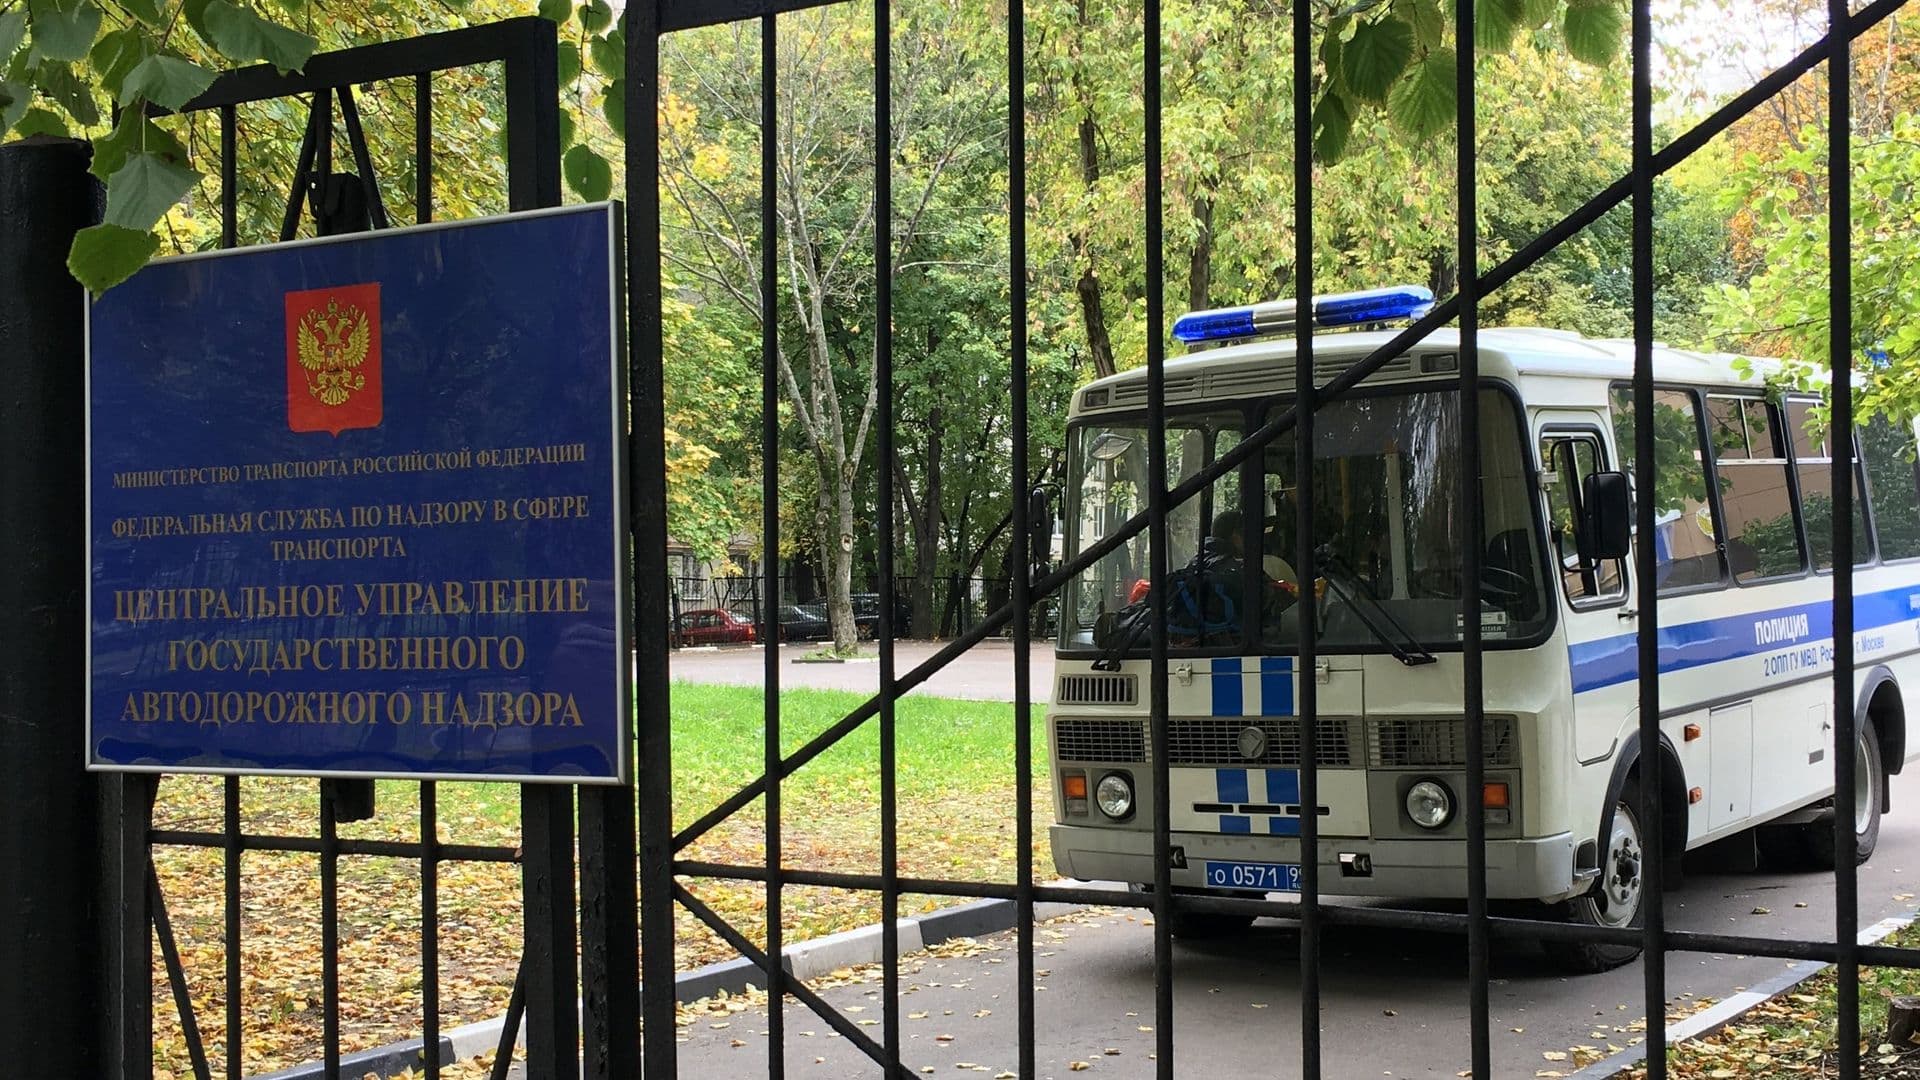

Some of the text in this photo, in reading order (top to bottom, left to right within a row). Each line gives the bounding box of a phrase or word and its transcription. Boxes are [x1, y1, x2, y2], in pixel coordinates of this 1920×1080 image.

[112, 443, 585, 488] МИНИСТЕРСТВО ТРАНСПОРТА РОССИЙСКОЙ ФЕДЕРАЦИИ
[111, 495, 590, 540] ФЕДЕРАЛЬНАЯ СЛУЖБА ПО НАДЗОРУ В СФЕРЕ
[270, 536, 407, 561] ТРАНСПОРТА
[114, 577, 590, 627] ЦЕНТРАЛЬНОЕ УПРАВЛЕНИЕ
[1754, 613, 1809, 646] ПОЛИЦИЯ
[167, 635, 526, 678] ГОСУДАРСТВЕННОГО
[1763, 658, 1770, 677] 2
[1771, 654, 1789, 676] ОПП
[1789, 651, 1799, 670] ГУ
[1800, 647, 1818, 668] МВД
[119, 691, 585, 732] АВТОДОРОЖНОГО НАДЗОРА
